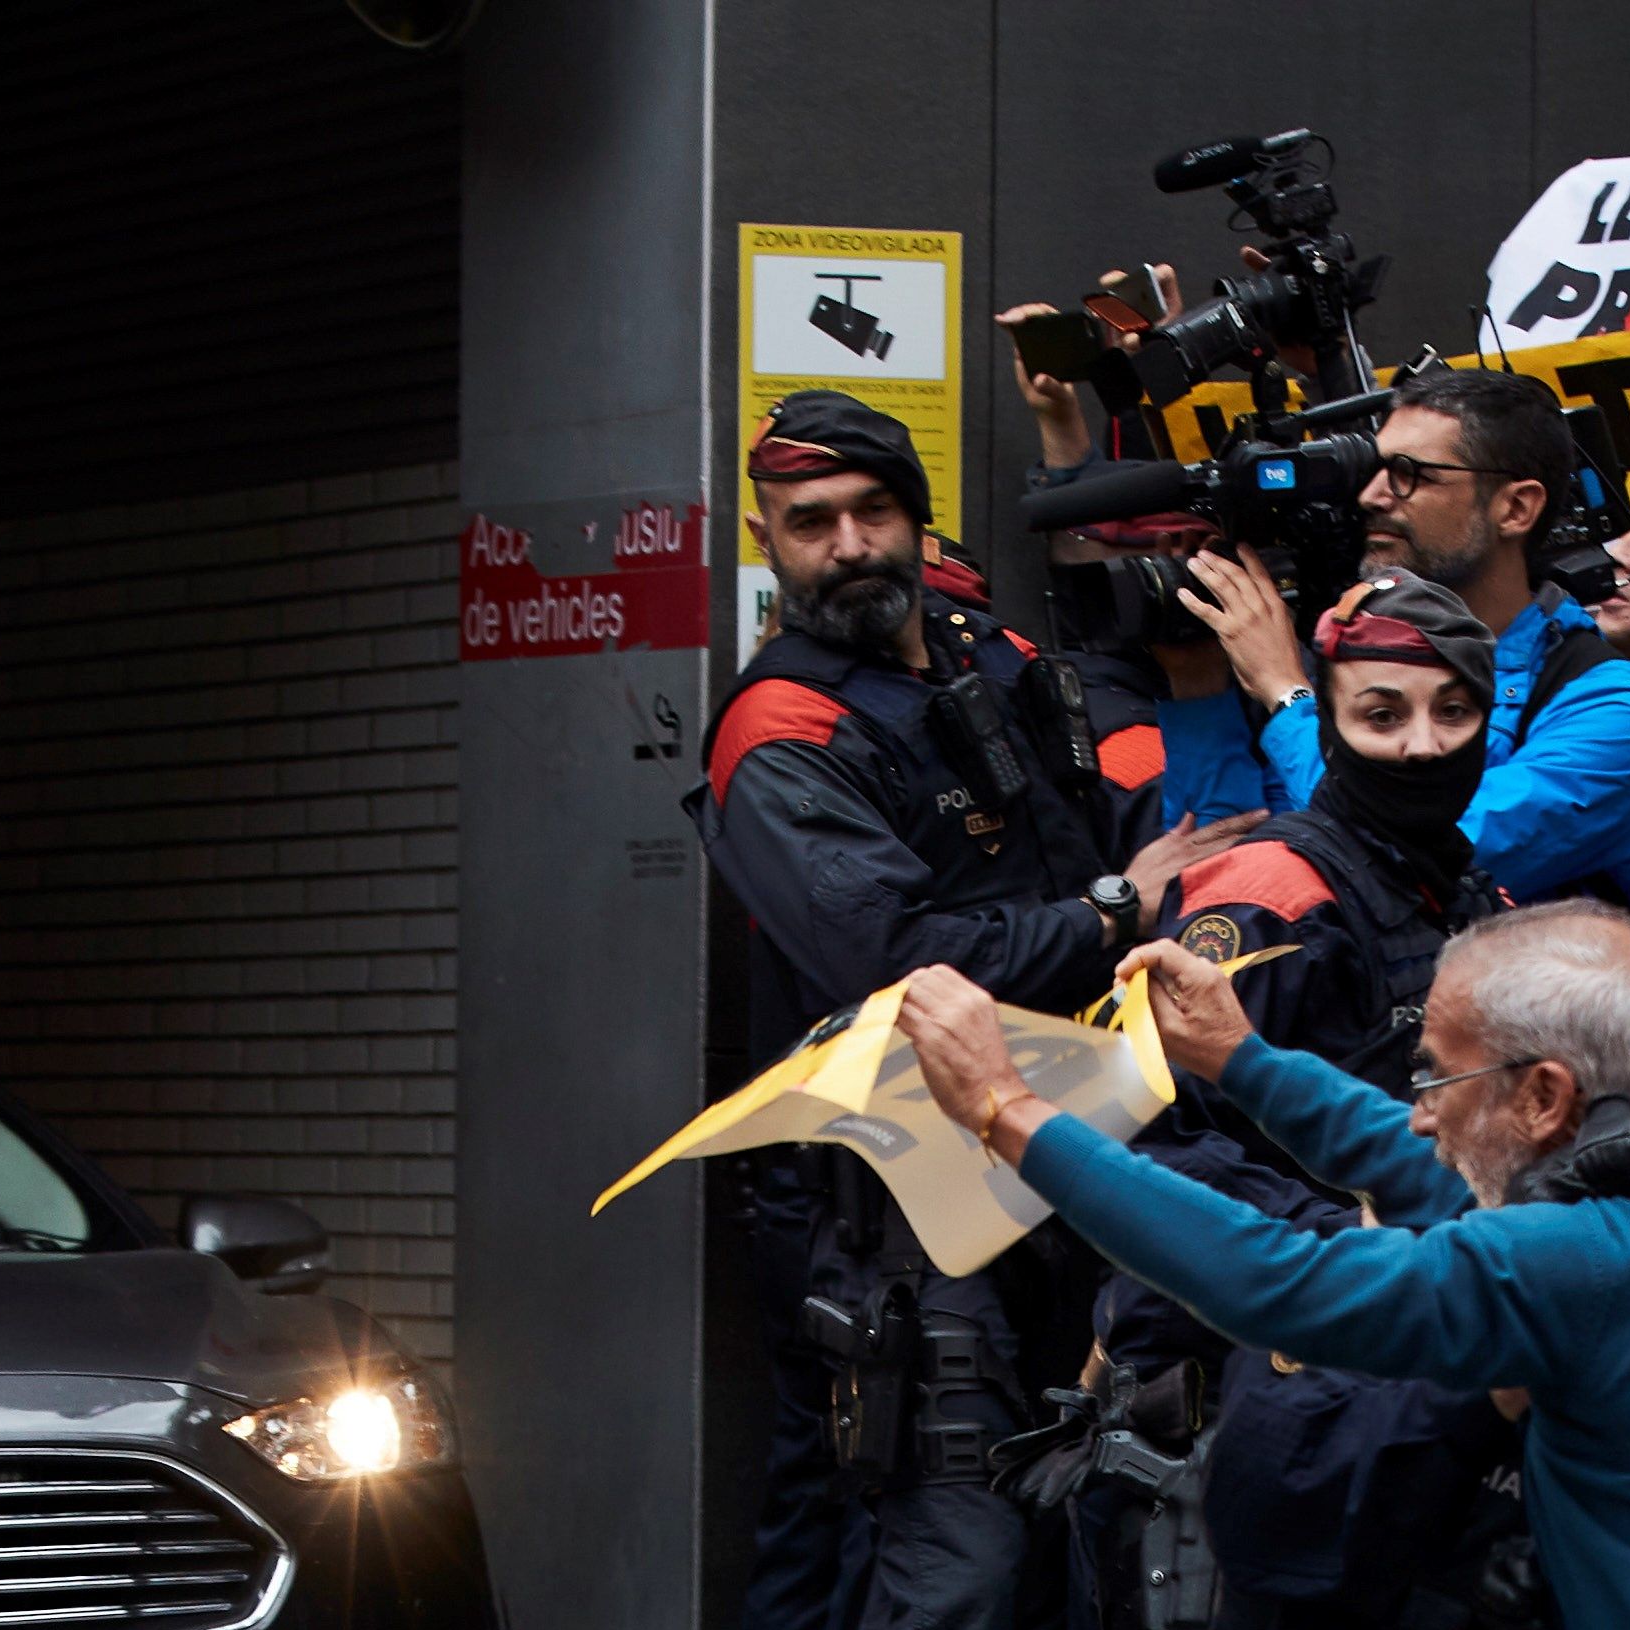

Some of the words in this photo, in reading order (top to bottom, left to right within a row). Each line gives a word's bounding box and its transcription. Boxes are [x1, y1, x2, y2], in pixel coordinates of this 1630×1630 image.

[753, 230, 802, 249] ZONA
[808, 233, 946, 254] VIDEOVIGILADA
[465, 588, 502, 647] de
[507, 580, 626, 644] vehicles
